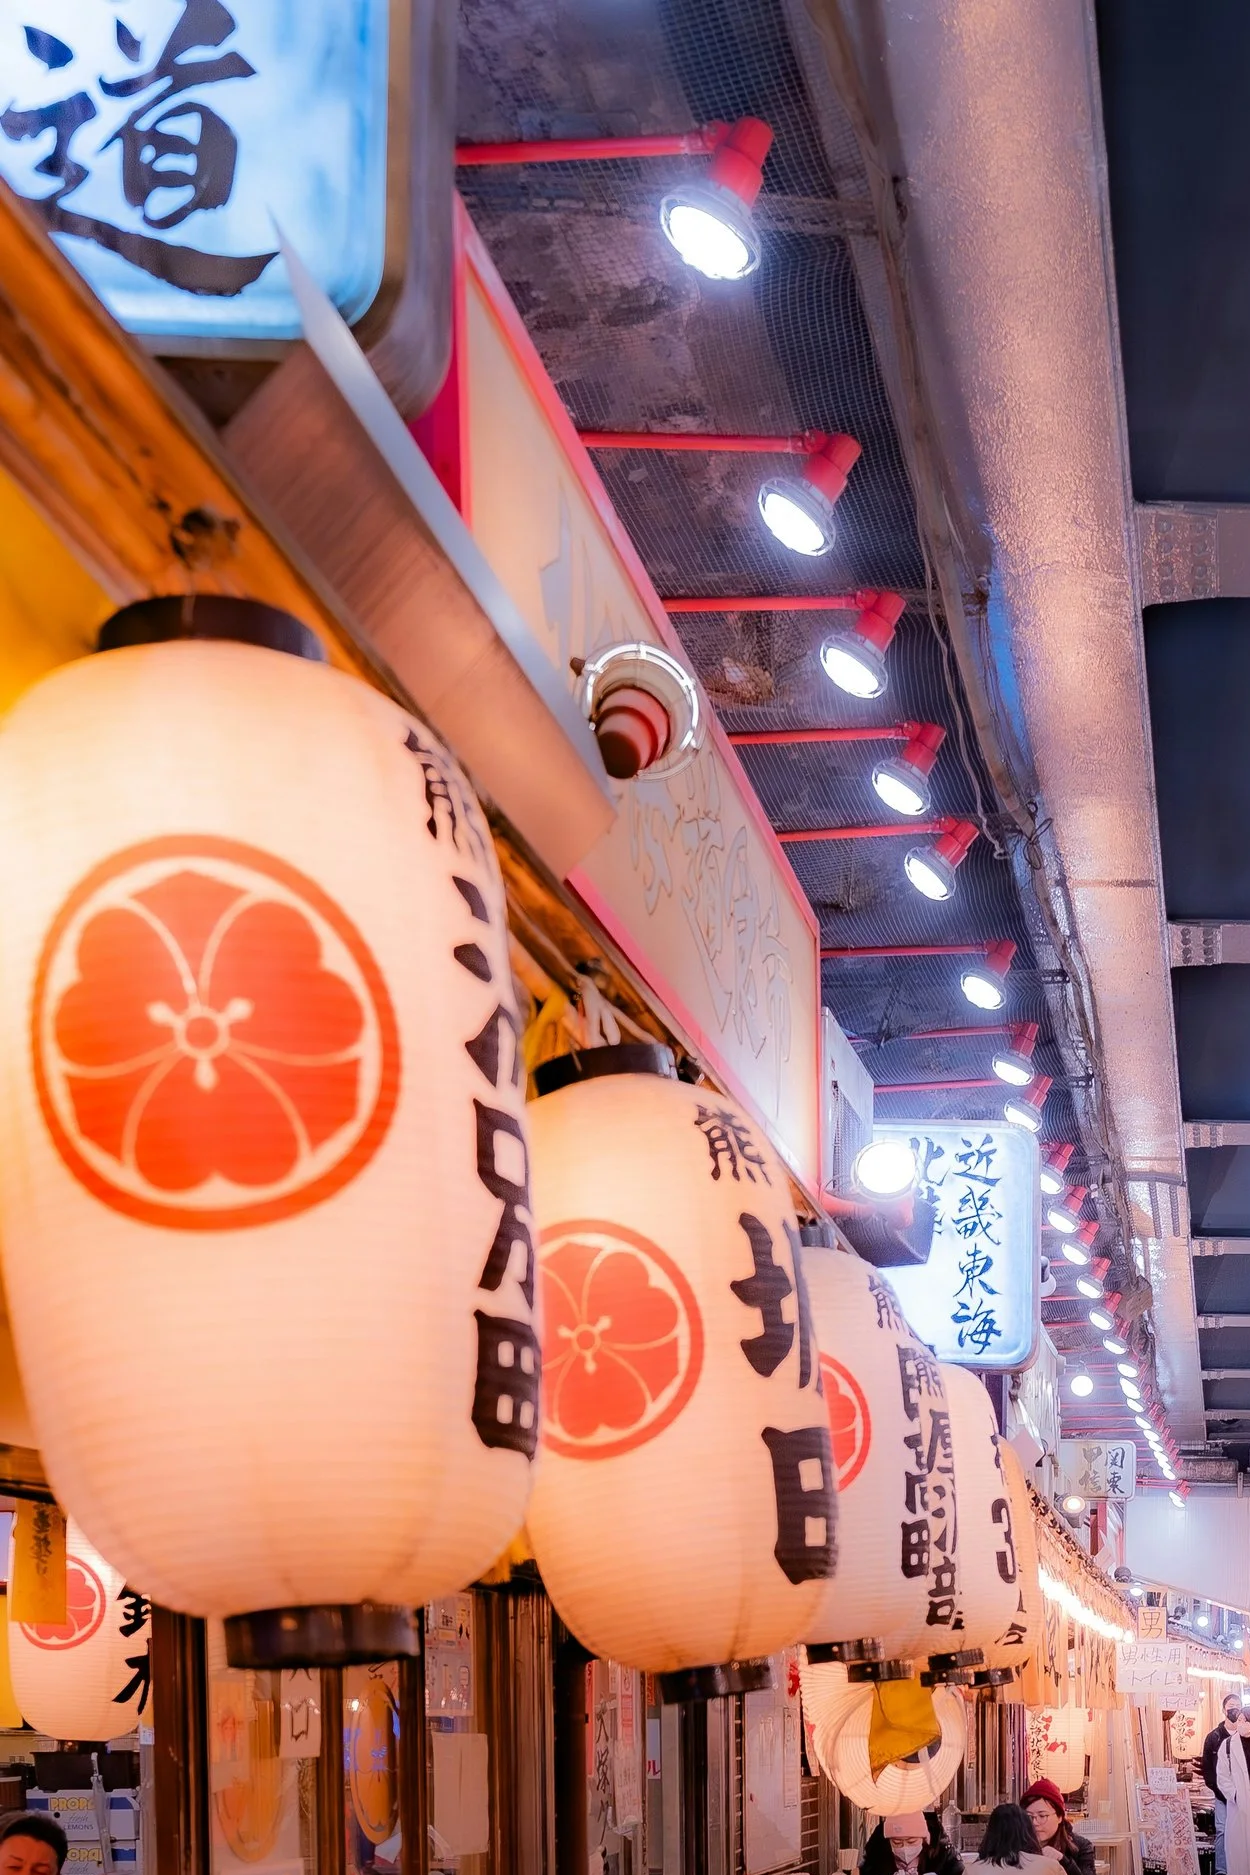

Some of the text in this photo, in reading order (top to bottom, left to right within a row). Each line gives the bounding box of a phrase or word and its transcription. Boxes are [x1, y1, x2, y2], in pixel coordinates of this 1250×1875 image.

[0, 0, 281, 297] 道
[952, 1133, 1003, 1355] 近畿東海
[1141, 1611, 1163, 1639] 男
